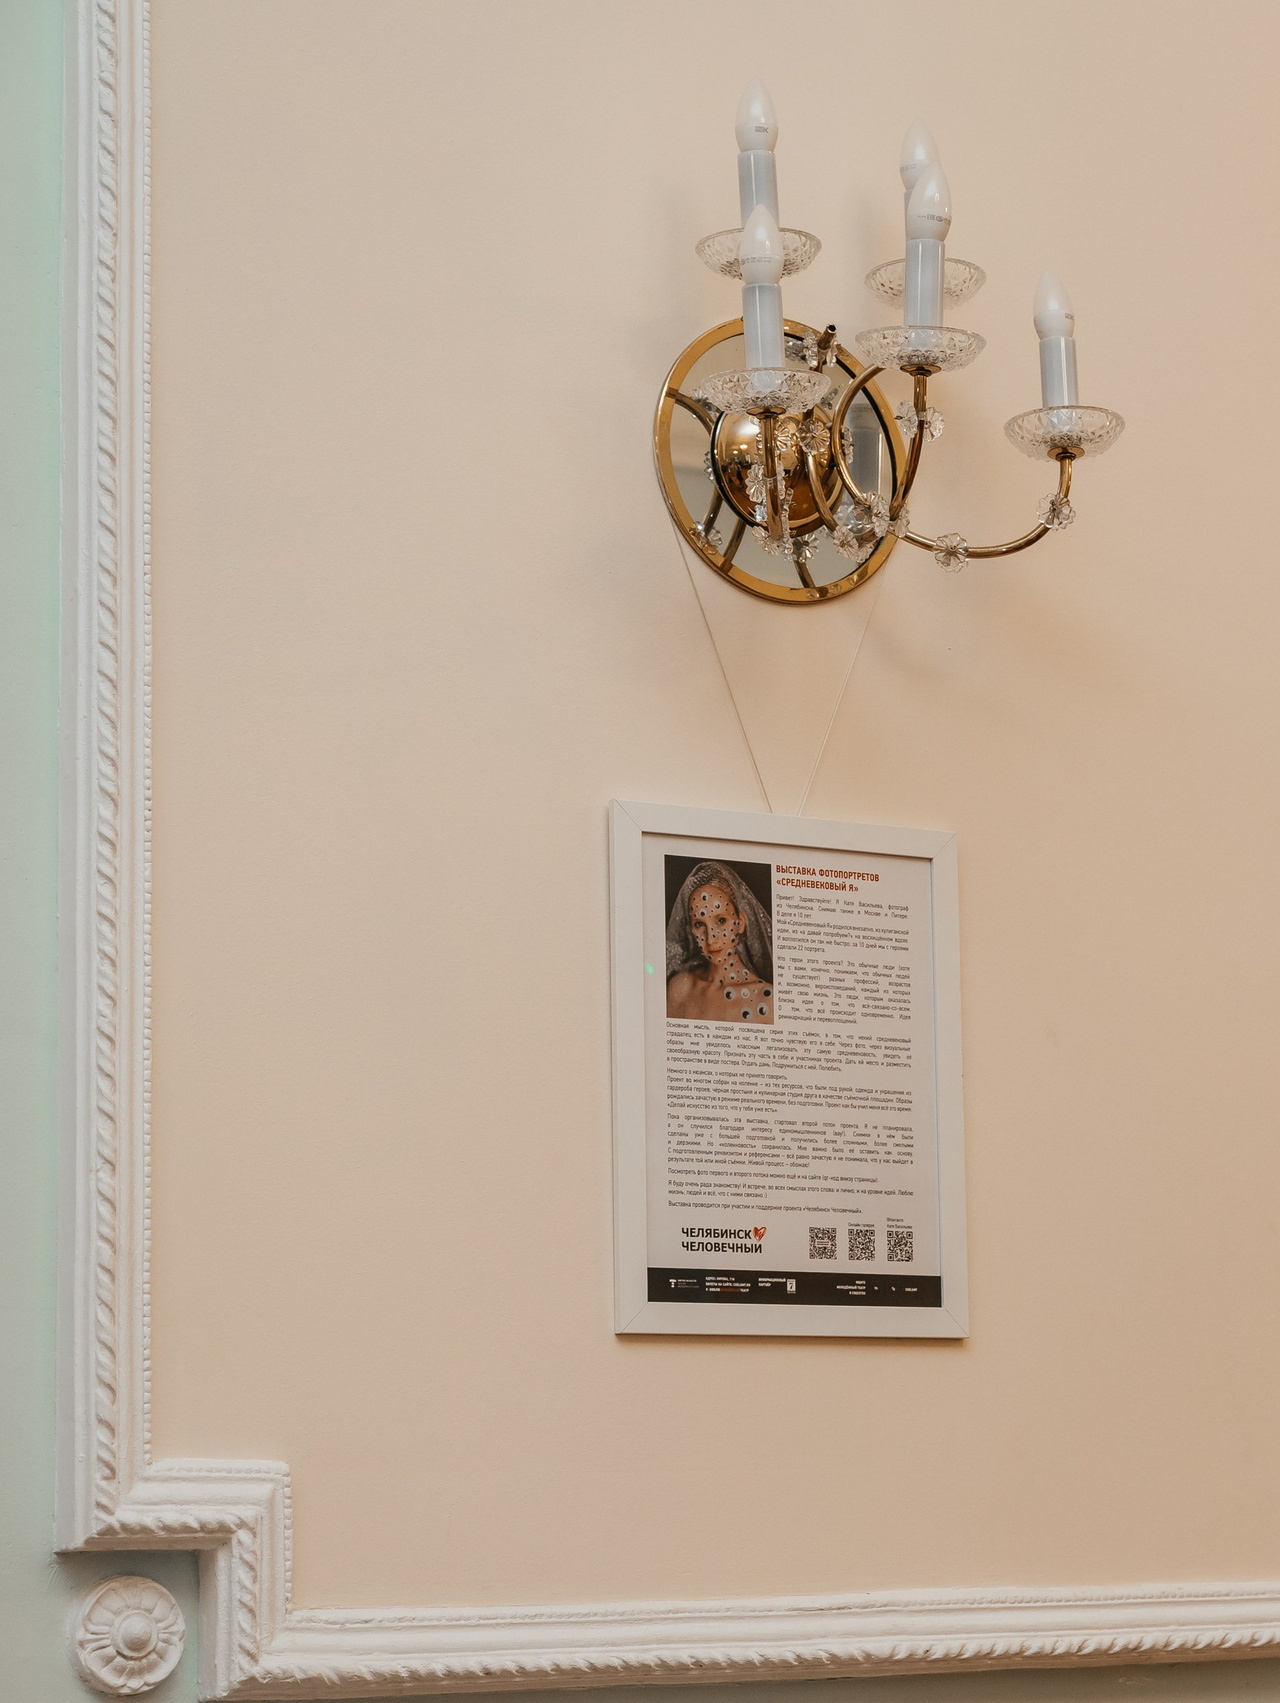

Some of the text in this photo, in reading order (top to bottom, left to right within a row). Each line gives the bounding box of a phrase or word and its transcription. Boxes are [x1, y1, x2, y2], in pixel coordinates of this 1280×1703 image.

[775, 864, 879, 882] ВЫСТАВКА ФОТОПОРТРЕТОВ
[848, 883, 858, 892] Я»
[681, 1226, 752, 1239] ЧЕЛЯБИНСК
